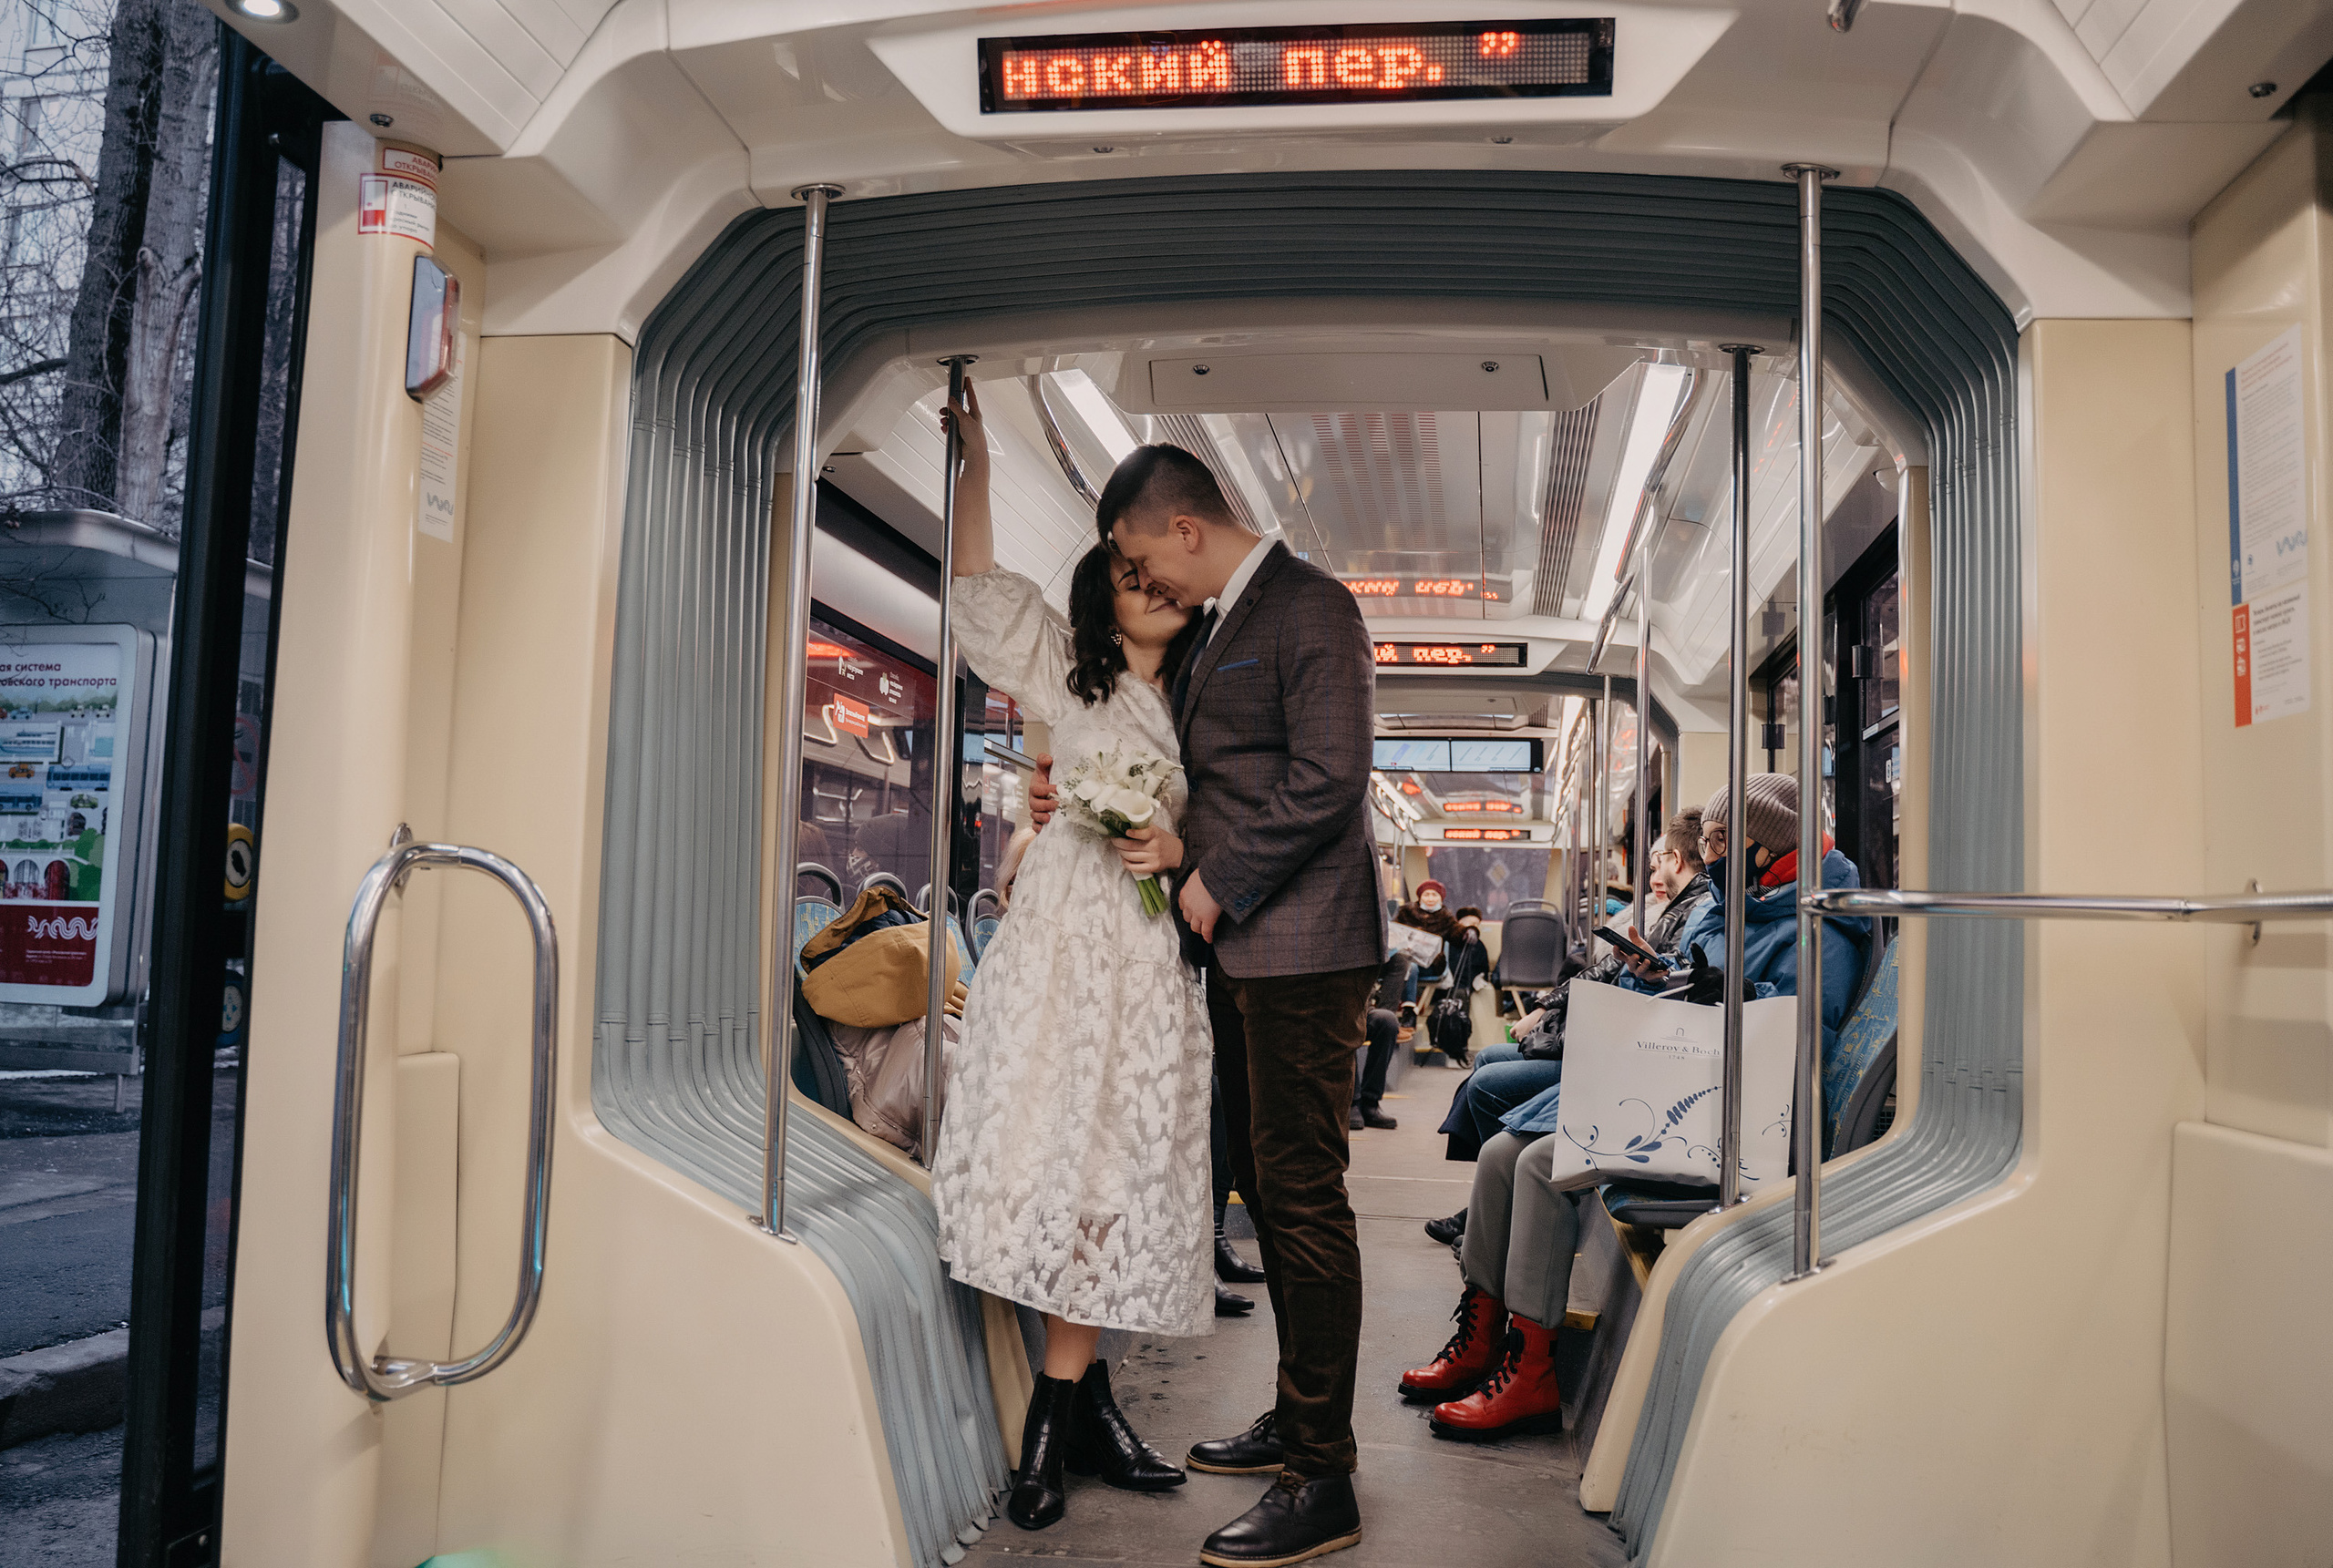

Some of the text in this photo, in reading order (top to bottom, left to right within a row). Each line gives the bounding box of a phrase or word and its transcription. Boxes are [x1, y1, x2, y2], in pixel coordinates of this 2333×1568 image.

[1285, 46, 1444, 90] пер.
[1413, 647, 1472, 663] пер.
[15, 663, 61, 672] система
[49, 678, 117, 690] транспорта
[1692, 1047, 1721, 1055] Boch
